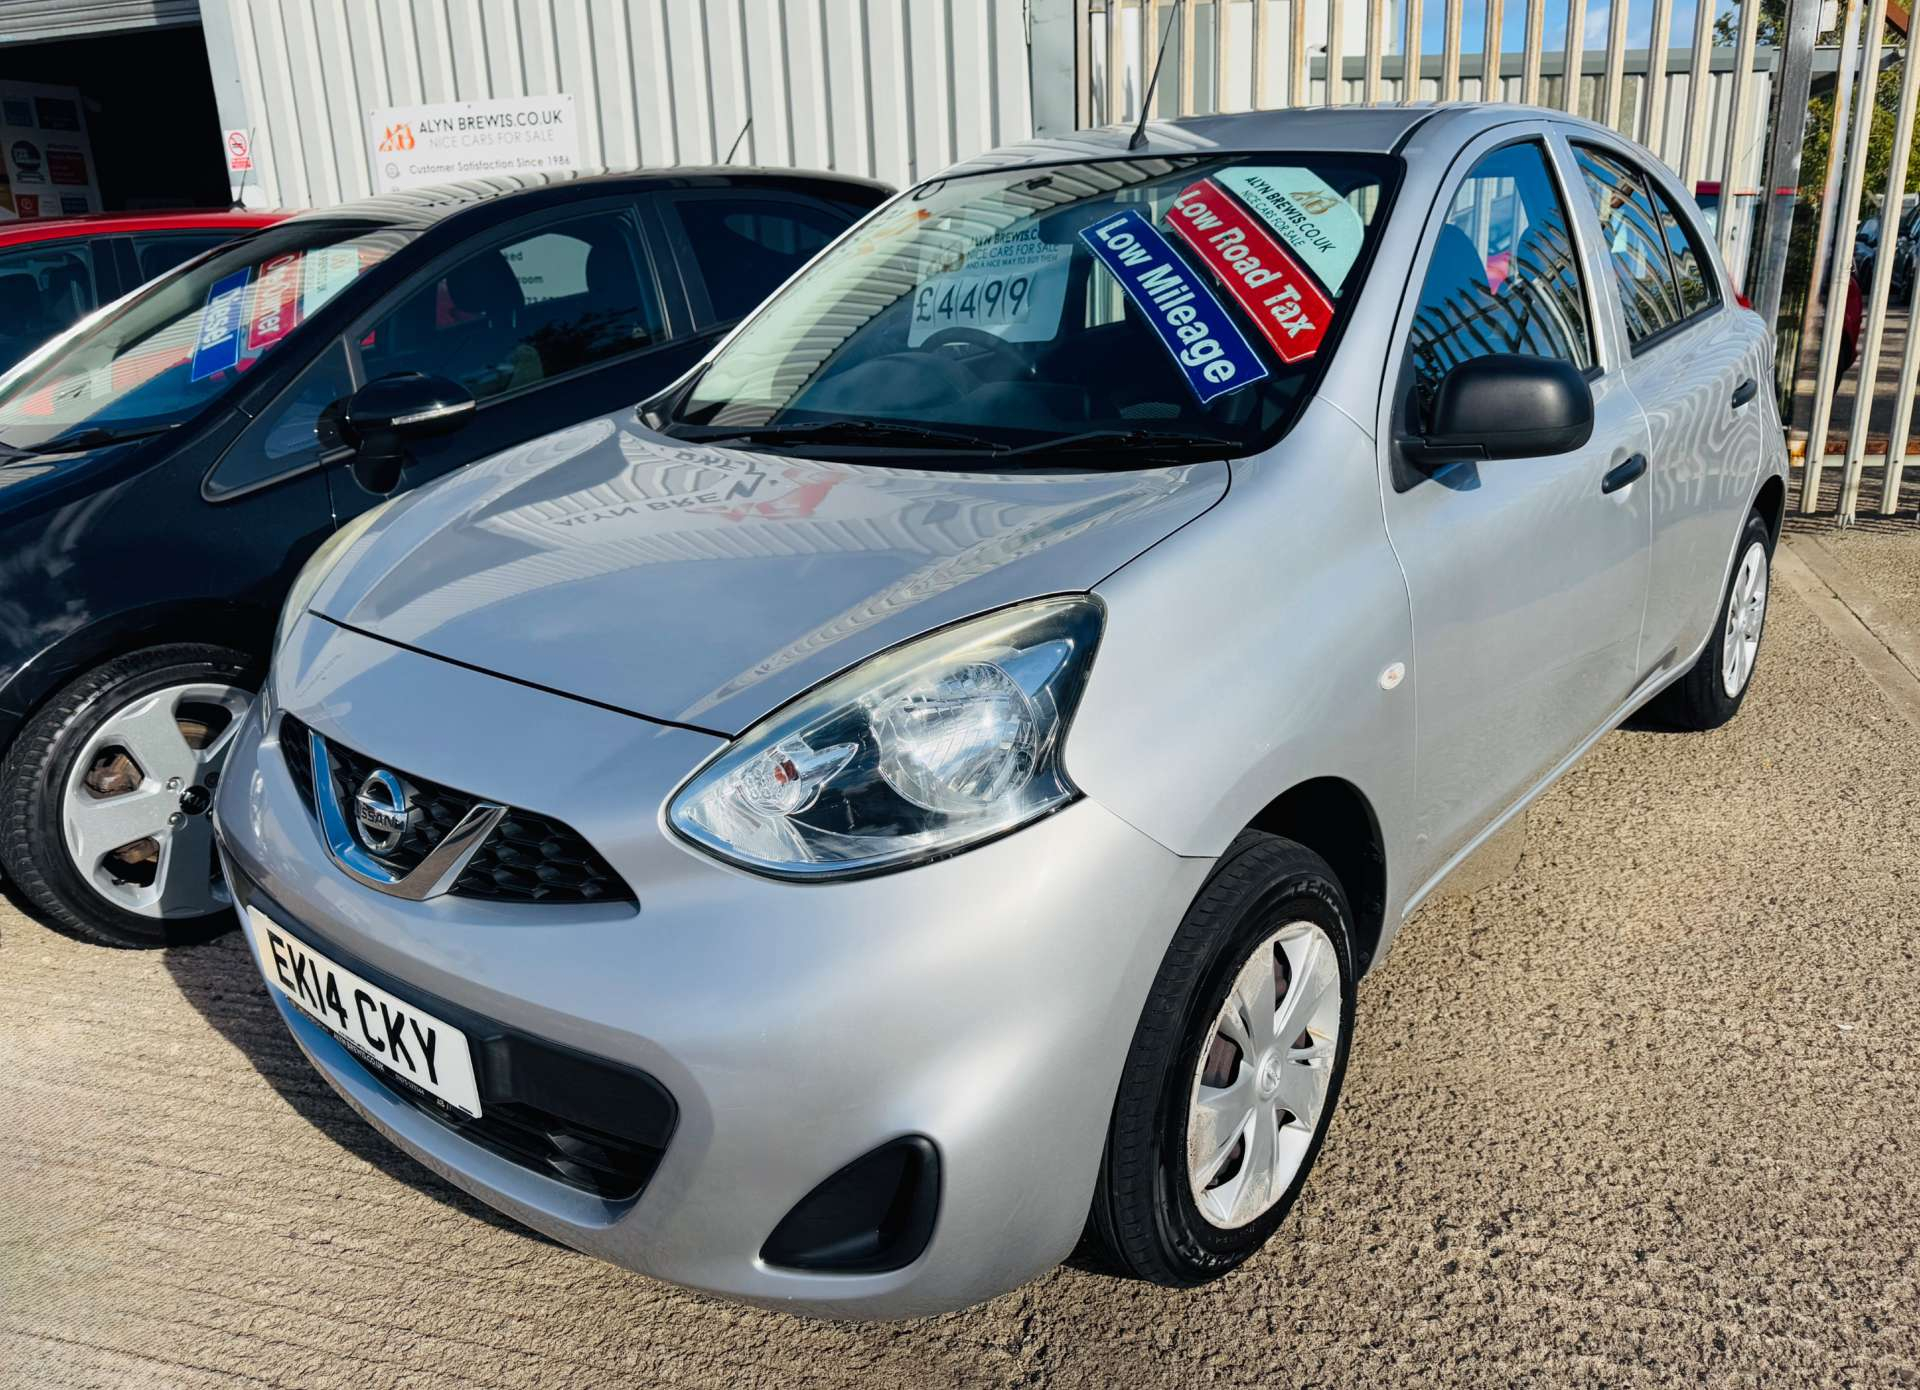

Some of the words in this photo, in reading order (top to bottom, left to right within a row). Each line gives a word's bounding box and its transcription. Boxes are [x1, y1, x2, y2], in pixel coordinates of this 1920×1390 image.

[419, 118, 454, 133] ALYN
[458, 110, 563, 131] BREWIS.CO.UK
[429, 136, 458, 149] NICE
[461, 133, 494, 147] CARS
[498, 131, 520, 144] FOR
[526, 129, 554, 143] SALE
[409, 163, 455, 175] Customer
[457, 159, 514, 171] Satisfaction
[516, 157, 544, 169] Since
[547, 155, 571, 166] 1986
[1241, 190, 1259, 208] NICE
[1254, 201, 1277, 224] CARS
[1273, 217, 1290, 234] FOR
[1283, 228, 1305, 248] SALE
[1244, 175, 1275, 200] ALYN
[1267, 190, 1336, 253] BREWIS.CO.UK
[989, 245, 1014, 259] CARS
[1015, 244, 1035, 255] FOR
[1173, 189, 1224, 232] Low
[1208, 227, 1283, 290] Road
[1262, 285, 1316, 339] Tax
[916, 277, 1028, 322] £4499
[1096, 217, 1153, 267] Low
[1136, 263, 1236, 385] Mileage
[267, 928, 349, 1030] EK14
[354, 988, 439, 1086] CKY
